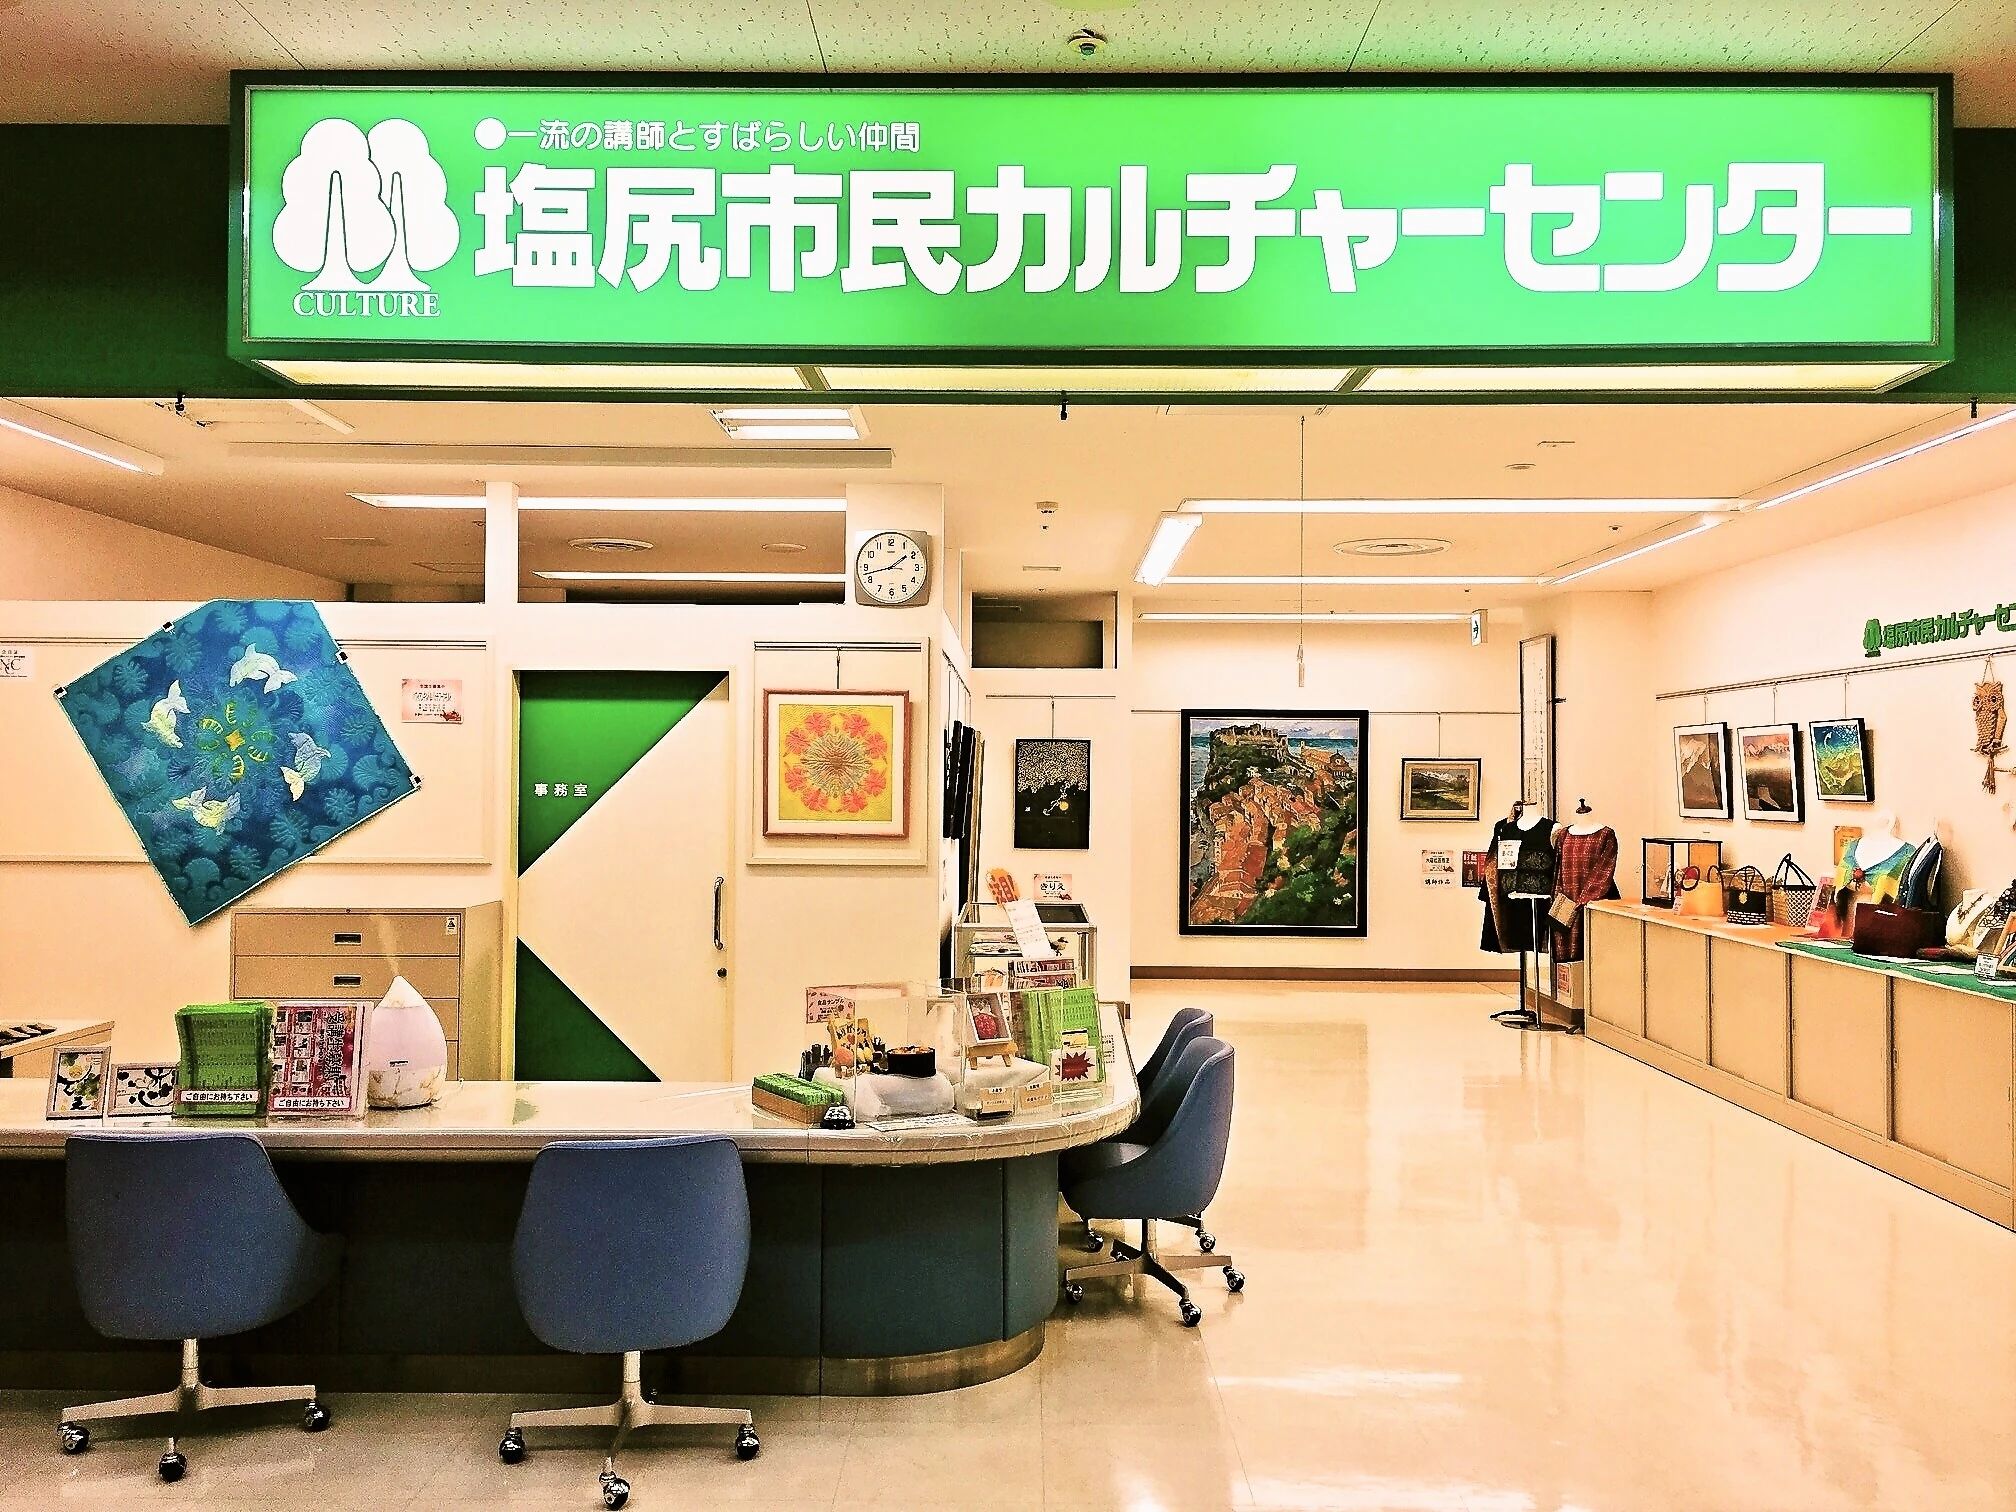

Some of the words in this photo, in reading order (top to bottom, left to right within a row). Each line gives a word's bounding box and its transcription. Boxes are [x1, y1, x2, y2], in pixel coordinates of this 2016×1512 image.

[508, 118, 921, 153] 一流の講師とすばらしい仲間
[474, 162, 1912, 295] 塩尻市民カルチャーセンター
[292, 292, 441, 318] CULTURE
[877, 542, 882, 550] 11
[903, 542, 906, 550] 1
[911, 551, 916, 559] 2
[915, 564, 919, 572] 3
[889, 588, 895, 596] 6
[534, 783, 588, 797] 事務室
[185, 1092, 253, 1101] ご自由にお持ち下さい
[278, 1099, 344, 1108] ご自由にお持ち下さい
